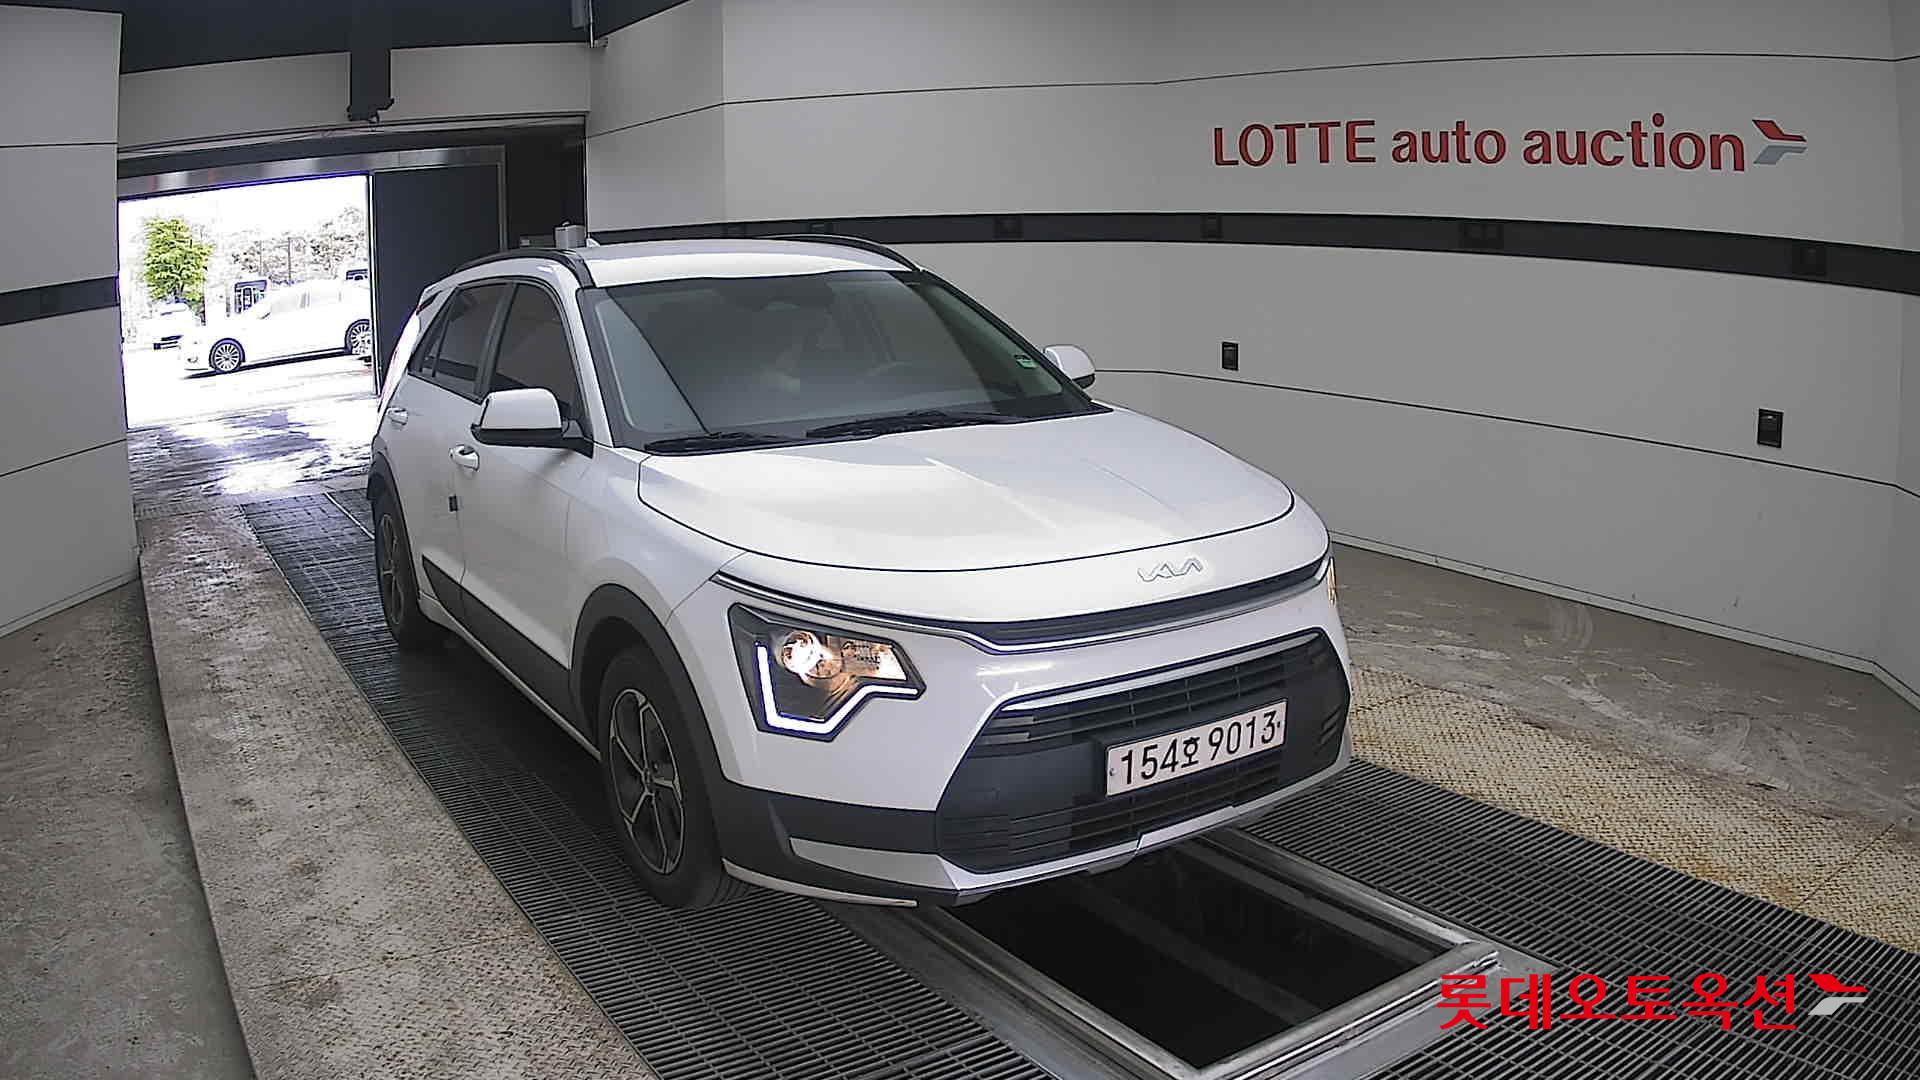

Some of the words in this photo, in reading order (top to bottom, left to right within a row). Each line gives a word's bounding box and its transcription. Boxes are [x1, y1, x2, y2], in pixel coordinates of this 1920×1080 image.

[1213, 119, 1376, 166] LOTTE
[1391, 120, 1507, 165] auto
[1522, 113, 1745, 171] auction
[1137, 558, 1203, 582] KIA
[1121, 736, 1200, 785] 154호
[1208, 710, 1277, 761] 9013
